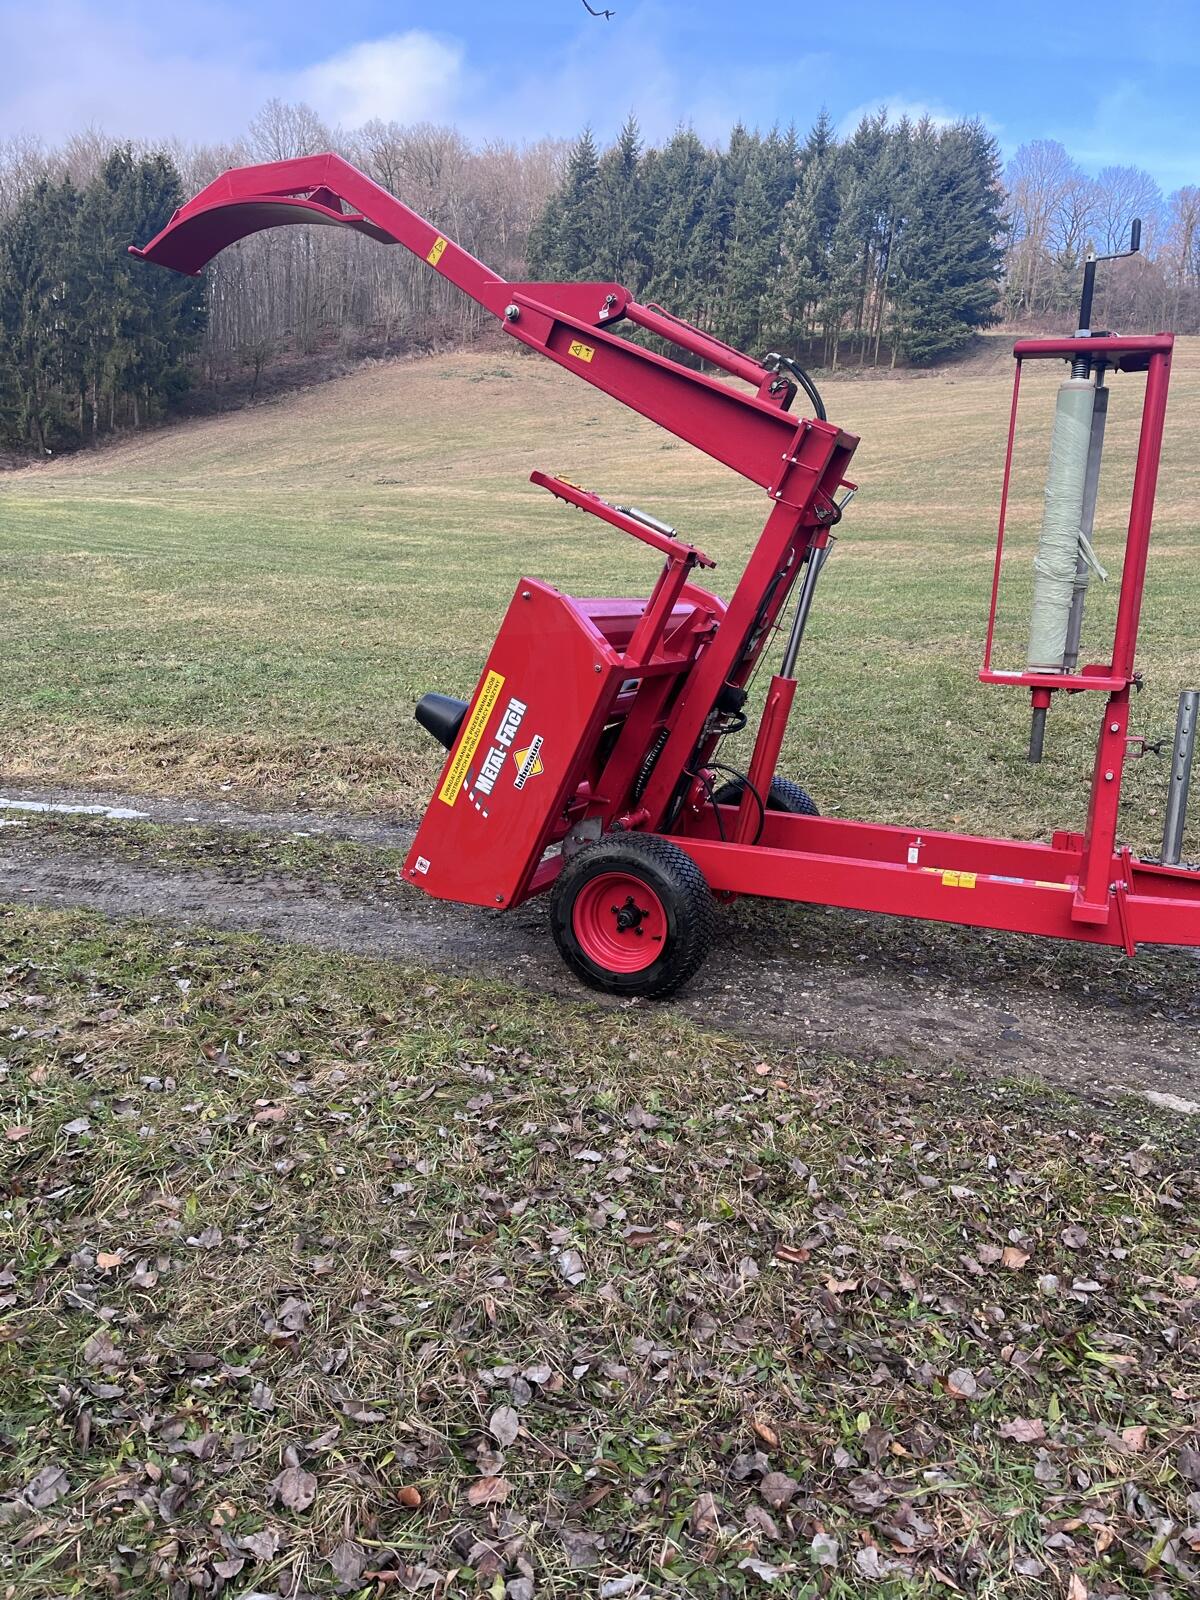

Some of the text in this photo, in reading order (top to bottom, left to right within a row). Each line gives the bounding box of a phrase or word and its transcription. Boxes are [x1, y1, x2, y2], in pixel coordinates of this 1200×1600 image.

[448, 760, 468, 800] POSTRONNYCH
[468, 728, 481, 752] POBLIŻU
[478, 707, 489, 728] PRACY
[486, 680, 500, 707] MASZYNY
[453, 745, 467, 773] ZABRANIA
[469, 694, 488, 735] PRZEBYWANIA
[485, 677, 495, 693] OSÓB
[475, 698, 527, 795] METAL-FACH
[514, 737, 543, 789] biberauer
